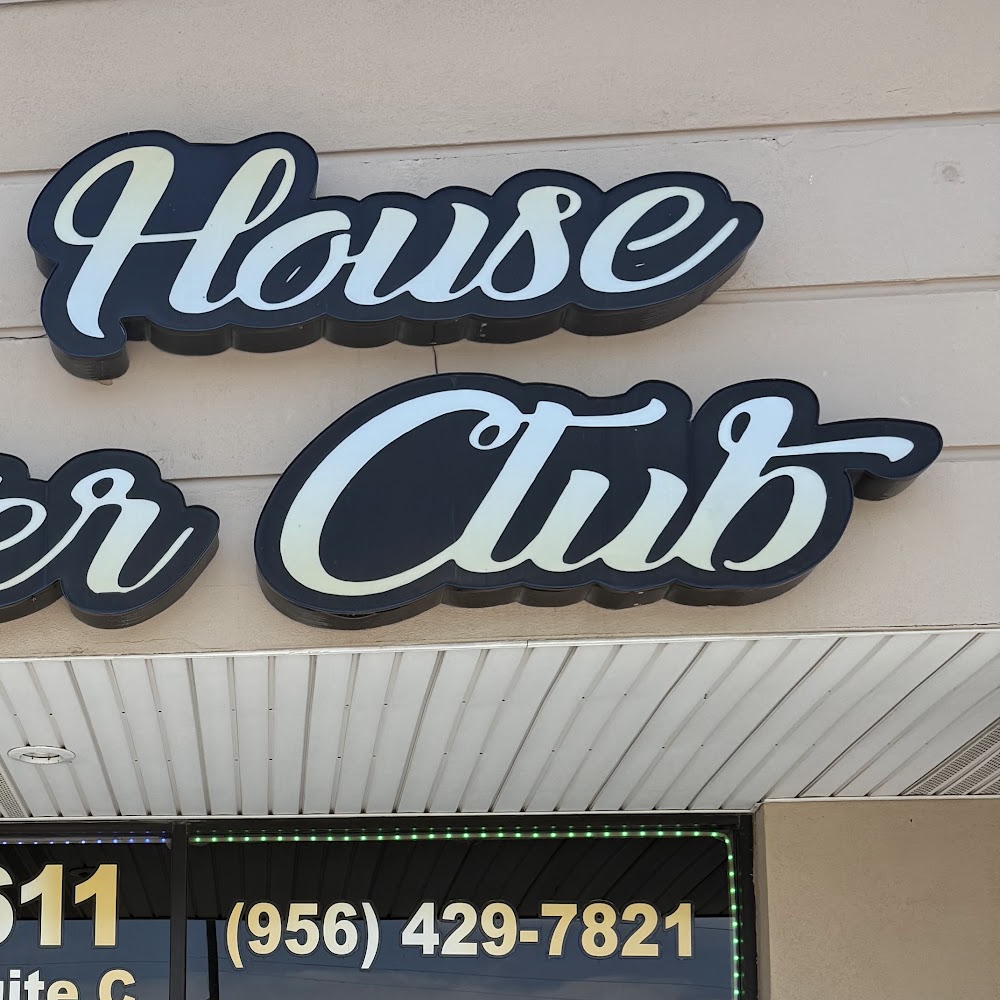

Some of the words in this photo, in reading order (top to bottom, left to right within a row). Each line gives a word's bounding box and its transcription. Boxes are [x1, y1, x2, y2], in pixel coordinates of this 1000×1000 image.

[54, 145, 738, 338] House
[279, 388, 914, 597] Club
[226, 901, 380, 970] (956)
[401, 902, 695, 958] 429-7821
